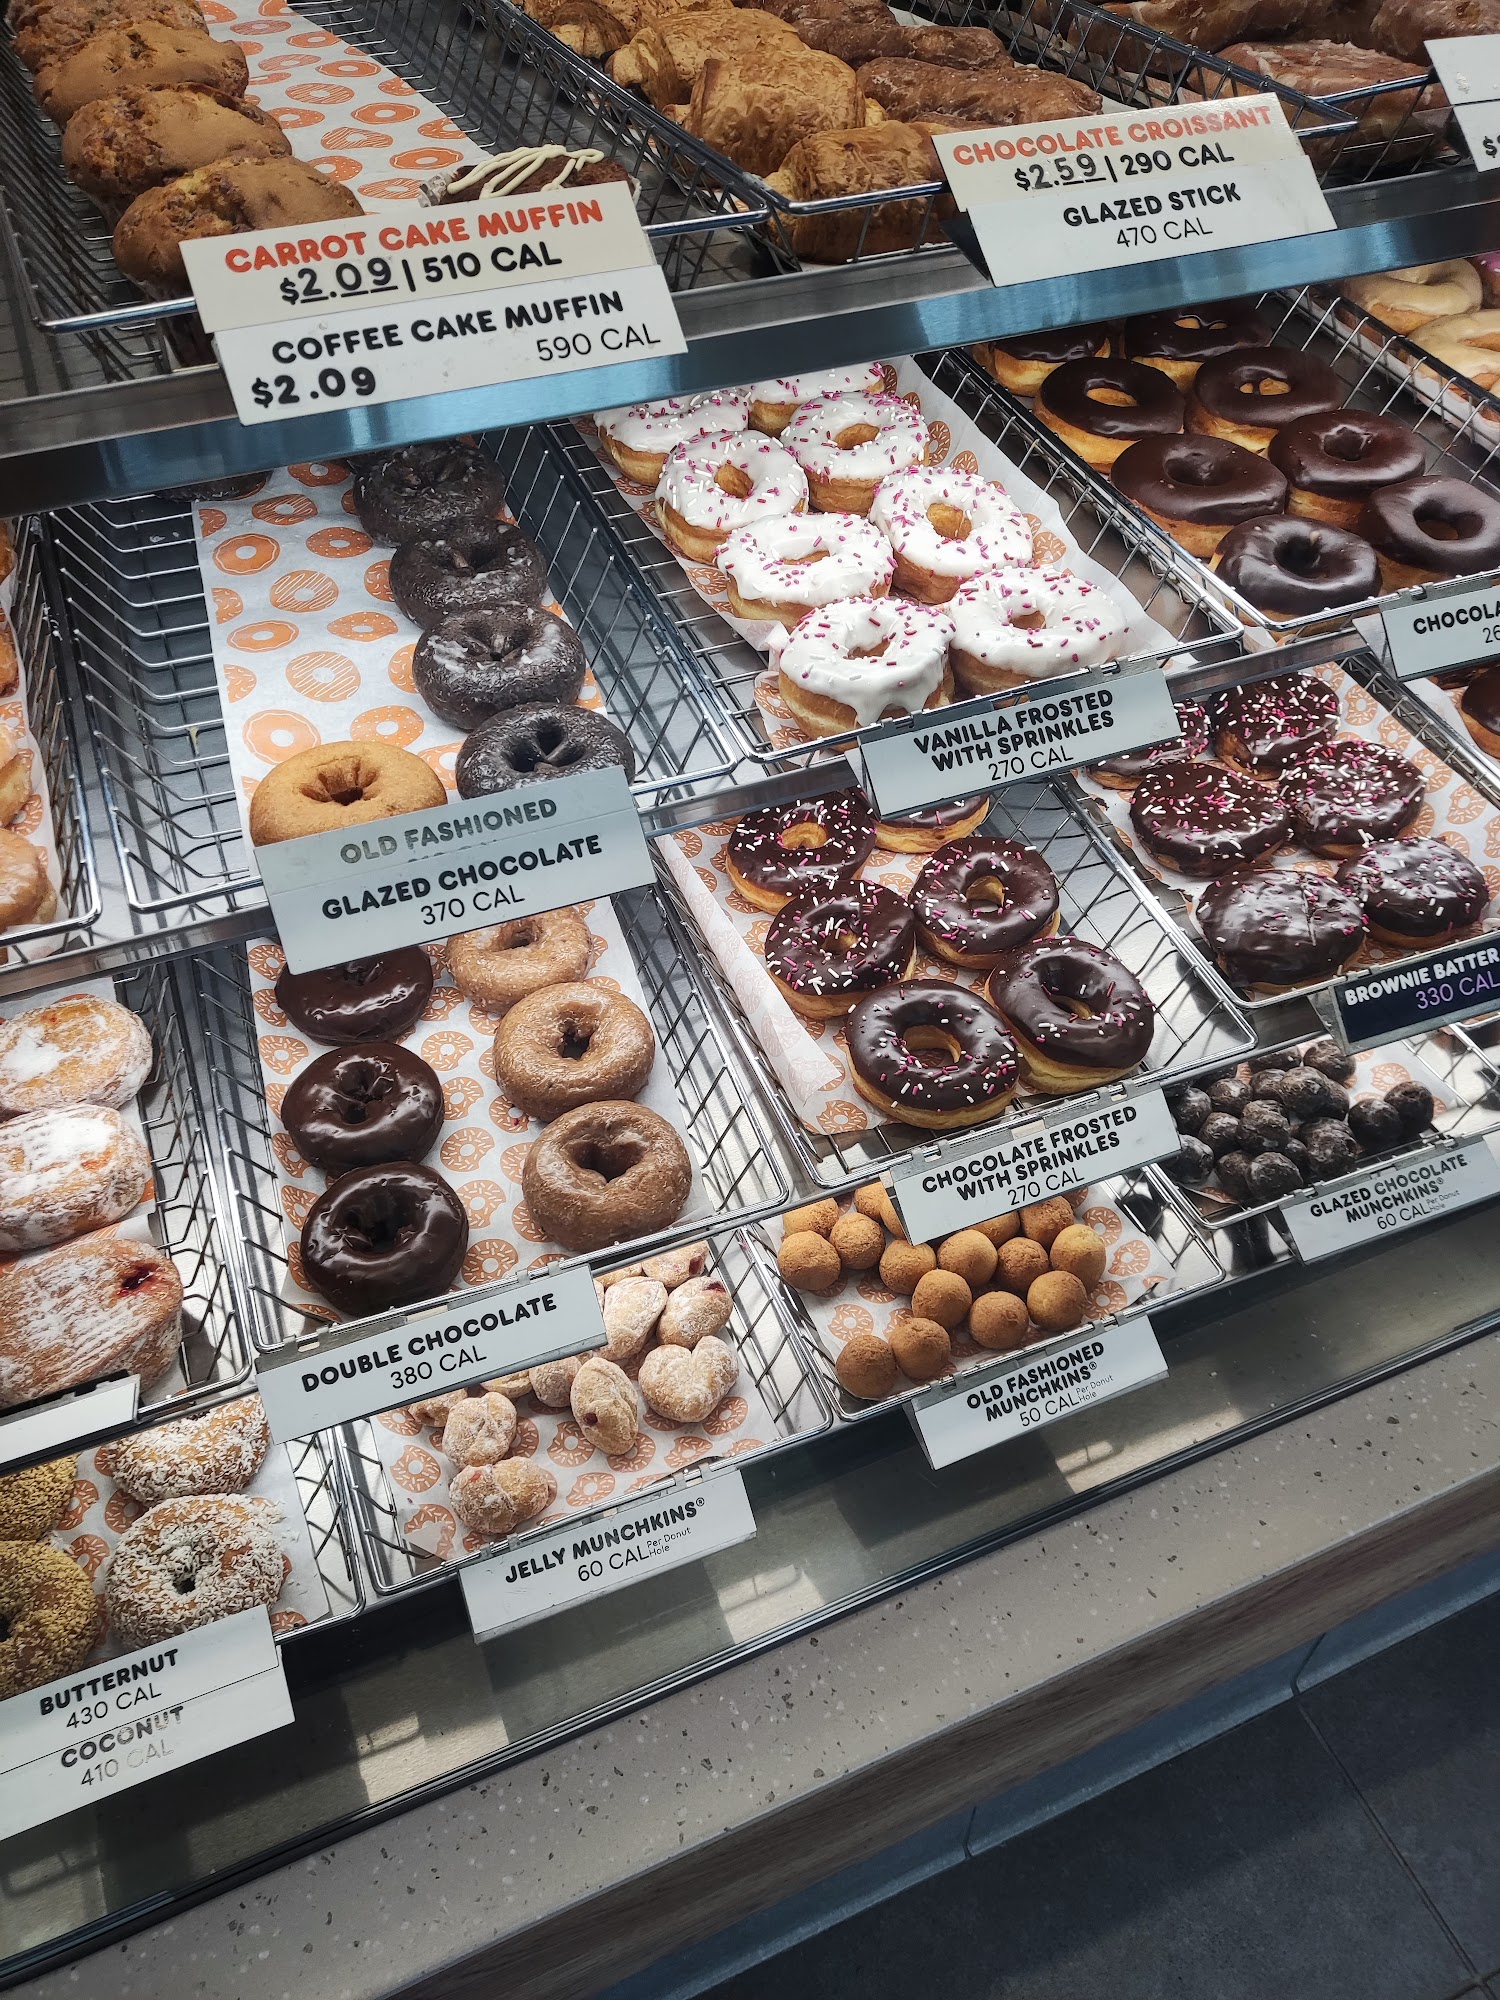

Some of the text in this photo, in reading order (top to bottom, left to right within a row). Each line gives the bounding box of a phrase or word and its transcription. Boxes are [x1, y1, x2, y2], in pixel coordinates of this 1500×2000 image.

[953, 106, 1272, 166] CHOCOLATE CROISSANT
[1014, 153, 1106, 192] $2.59
[1120, 150, 1171, 176] 290
[1179, 142, 1235, 168] CAL
[1063, 182, 1241, 227] GLAZED STICK
[225, 199, 603, 273] CARROT CAKE MUFFIN
[1117, 217, 1213, 248] 470 CAL
[280, 257, 398, 305] $2.09
[423, 250, 481, 283] 510
[491, 241, 562, 273] CAL
[272, 290, 624, 364] COFFEE CAKE MUFFIN
[536, 323, 661, 362] 590 CAL
[251, 366, 376, 409] $2.09
[914, 689, 1113, 754] VANILLA FROSTED
[931, 710, 1114, 772] WITH SPRINKLES
[988, 745, 1074, 781] 270 CAL
[340, 835, 398, 864] OLD
[404, 798, 558, 850] FASHIONED
[322, 877, 431, 919] GLAZED
[438, 834, 602, 890] CHOCOLATE
[420, 884, 525, 926] 370 CAL
[1344, 947, 1500, 1006] BROWNIE BATTER
[1415, 970, 1500, 1010] 330 CAL
[922, 1105, 1137, 1194] CHOCOLATE FROSTED
[956, 1131, 1120, 1201] WITH SPRINKLES
[1007, 1166, 1085, 1206] 270 CAL
[1310, 1154, 1468, 1218] GLAZED CHOCOLATE
[1377, 1202, 1430, 1230] 60 CAL
[301, 1292, 557, 1393] DOUBLE CHOCOLATE
[390, 1344, 487, 1390] 380 CAL
[966, 1341, 1105, 1409] OLD FASHIONED
[1076, 1374, 1114, 1396] Per Donut
[1020, 1395, 1080, 1427] 50 CAL
[1078, 1389, 1098, 1404] Hole
[647, 1527, 692, 1549] Per Donut
[649, 1544, 671, 1558] Hole
[505, 1547, 566, 1584] JELLY
[578, 1545, 650, 1582] 60 CAL
[39, 1648, 179, 1716] BUTTERNUT
[65, 1682, 162, 1729] 430 CAL
[60, 1705, 184, 1768] COCONUT
[80, 1739, 175, 1787] 410 CAL
